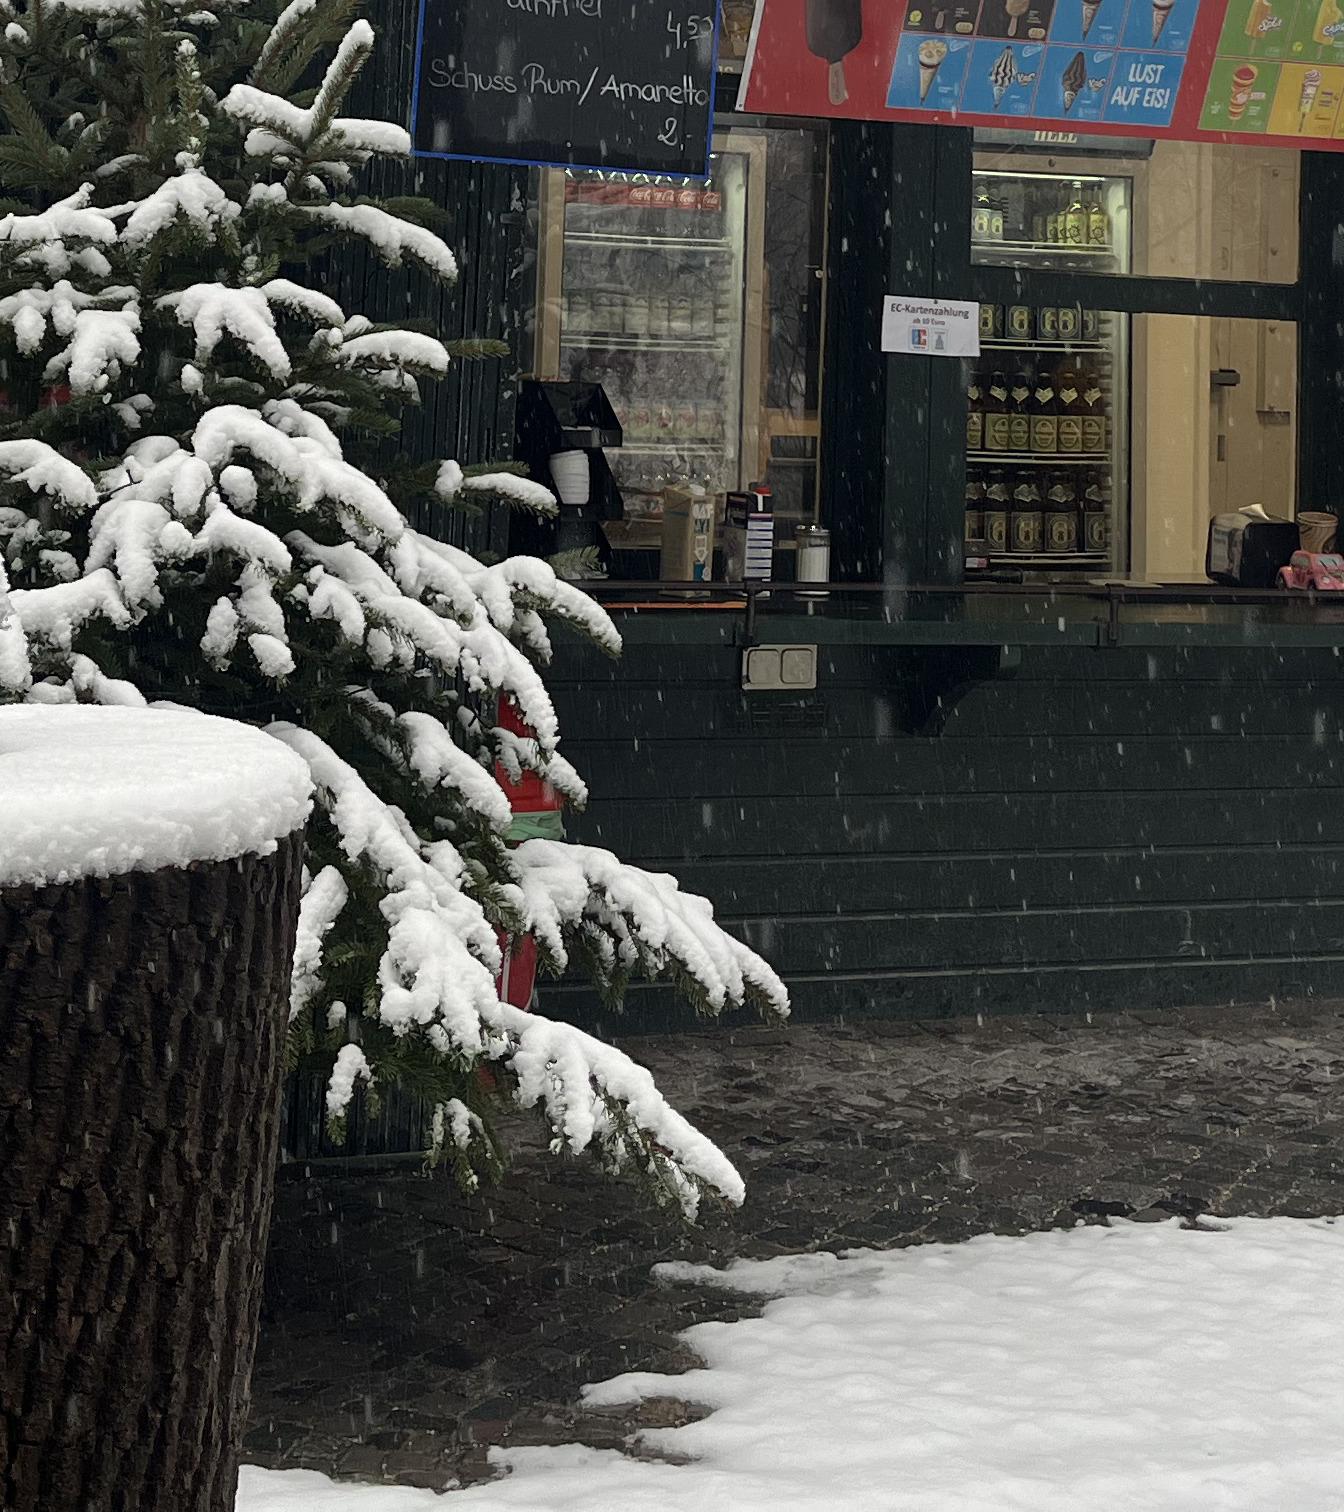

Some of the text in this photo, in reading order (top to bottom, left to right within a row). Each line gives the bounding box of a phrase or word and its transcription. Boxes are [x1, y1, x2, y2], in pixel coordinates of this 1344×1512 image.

[428, 58, 518, 94] Schuss
[1128, 63, 1165, 84] LUST
[1110, 86, 1142, 106] AUF
[890, 303, 970, 320] EC-Kartenzahlung
[931, 318, 946, 326] Euro
